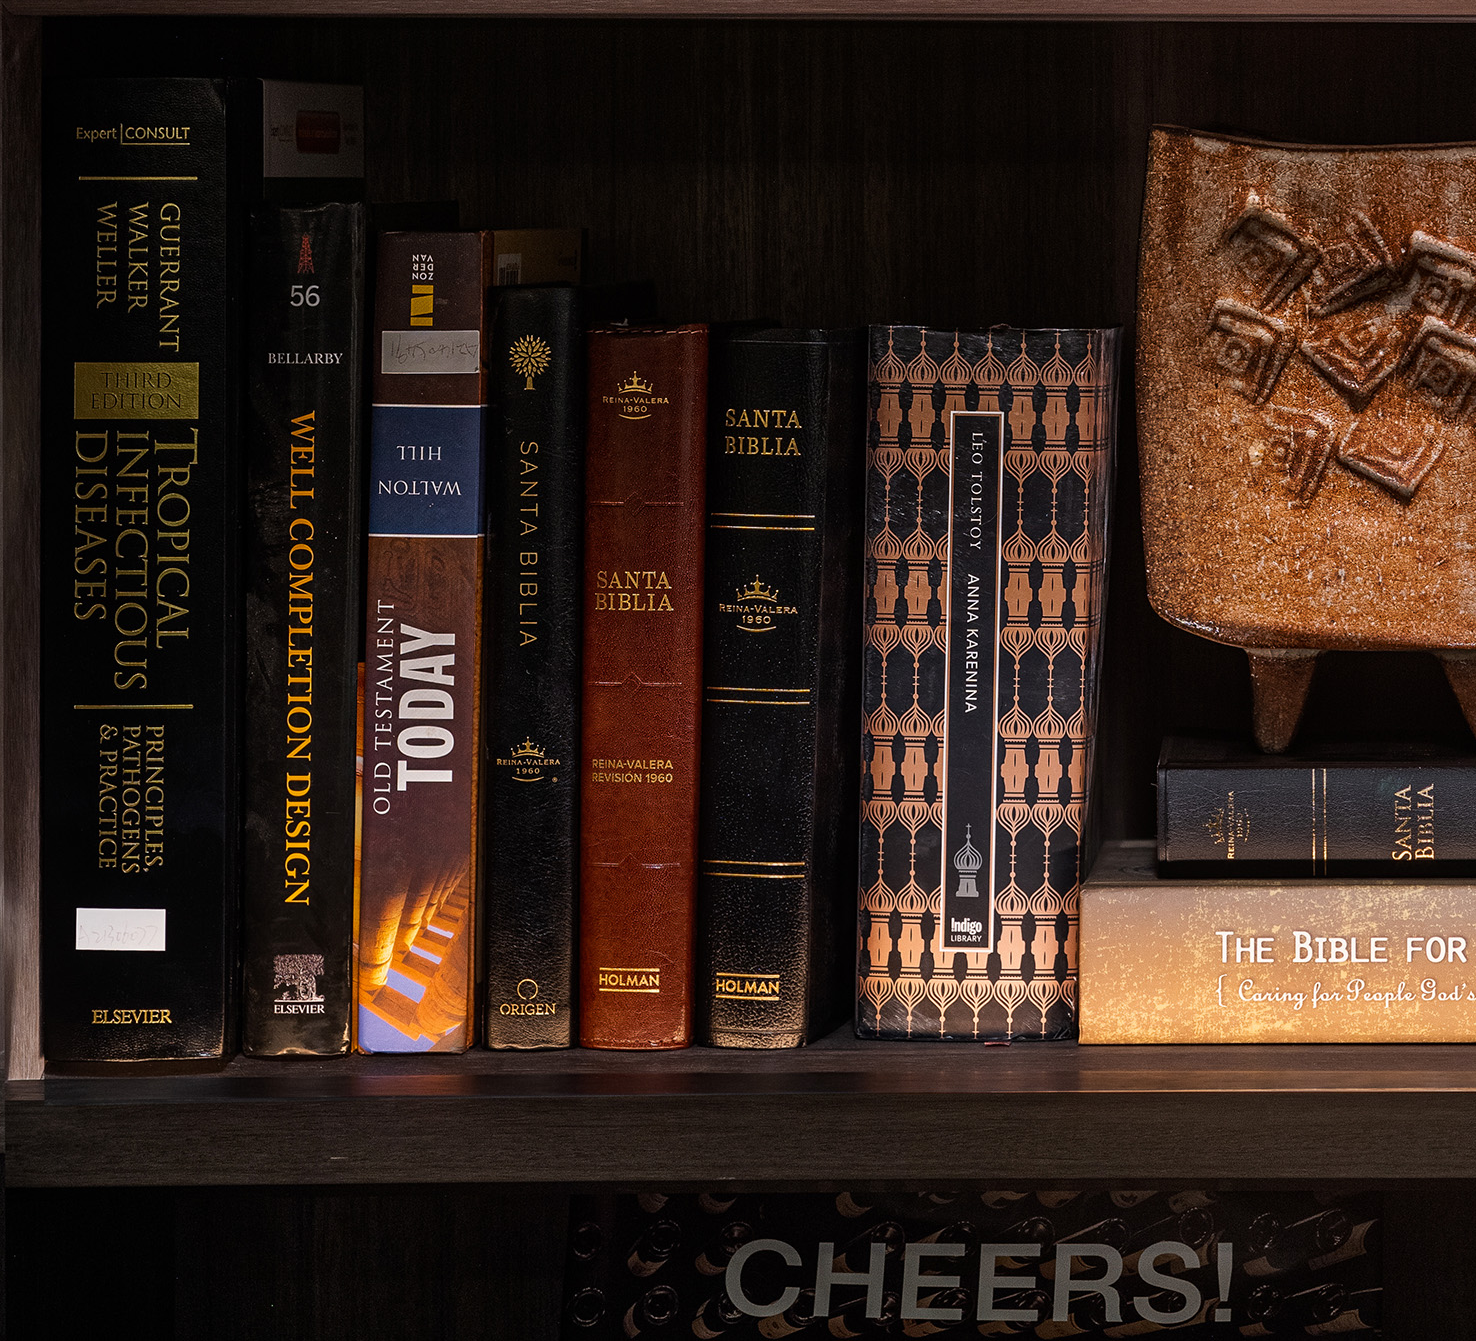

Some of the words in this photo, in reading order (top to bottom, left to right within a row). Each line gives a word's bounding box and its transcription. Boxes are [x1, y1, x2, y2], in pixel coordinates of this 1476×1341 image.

[76, 126, 117, 142] Expert
[125, 126, 190, 140] CONSULT
[96, 201, 118, 309] WELLER
[127, 201, 149, 313] WALKER
[160, 202, 181, 352] GUERRANT
[290, 285, 320, 308] 56
[100, 371, 172, 389] THIRD
[268, 353, 343, 366] BELLARBY
[91, 393, 182, 410] EDITION
[725, 409, 802, 429] SANTA
[290, 410, 316, 510] WELL
[397, 445, 442, 460] HILL
[725, 436, 801, 456] BIBLIA
[972, 431, 983, 464] LEO
[378, 479, 461, 496] WALTON
[519, 441, 539, 537] SANTA
[970, 473, 983, 550] TOLSTOY
[73, 430, 109, 620] DISEASES
[154, 427, 199, 649] TROPICAL
[114, 430, 149, 690] INFECTIOUS
[596, 571, 672, 589] SANTA
[519, 552, 538, 647] BIBLIA
[595, 593, 674, 612] BIBLIA
[966, 574, 979, 622] ANNA
[286, 518, 316, 760] COMPLETION
[374, 600, 394, 751] TESTAMENT
[964, 628, 979, 713] KARENINA
[99, 724, 117, 740] &
[397, 623, 456, 791] TODAY
[373, 762, 391, 815] OLD
[592, 759, 673, 770] REINA-VALERA
[98, 748, 119, 869] PRACTICE
[122, 725, 142, 874] PATHOGENS
[145, 725, 165, 872] PRINCIPLES,
[1392, 785, 1411, 862] SANTA
[1415, 783, 1434, 859] BIBLIA
[284, 773, 312, 905] DESIGN
[951, 918, 982, 934] Indigo
[1216, 931, 1274, 963] THE
[1293, 931, 1388, 963] BIBLE
[1406, 935, 1467, 963] FOR
[600, 973, 660, 988] HOLMAN
[716, 978, 780, 994] HOLMAN
[92, 1008, 172, 1025] ELSEVIER
[274, 1004, 325, 1014] ELSEVIER
[500, 1003, 556, 1016] ORIGEN
[724, 1238, 1234, 1323] CHEERS!
